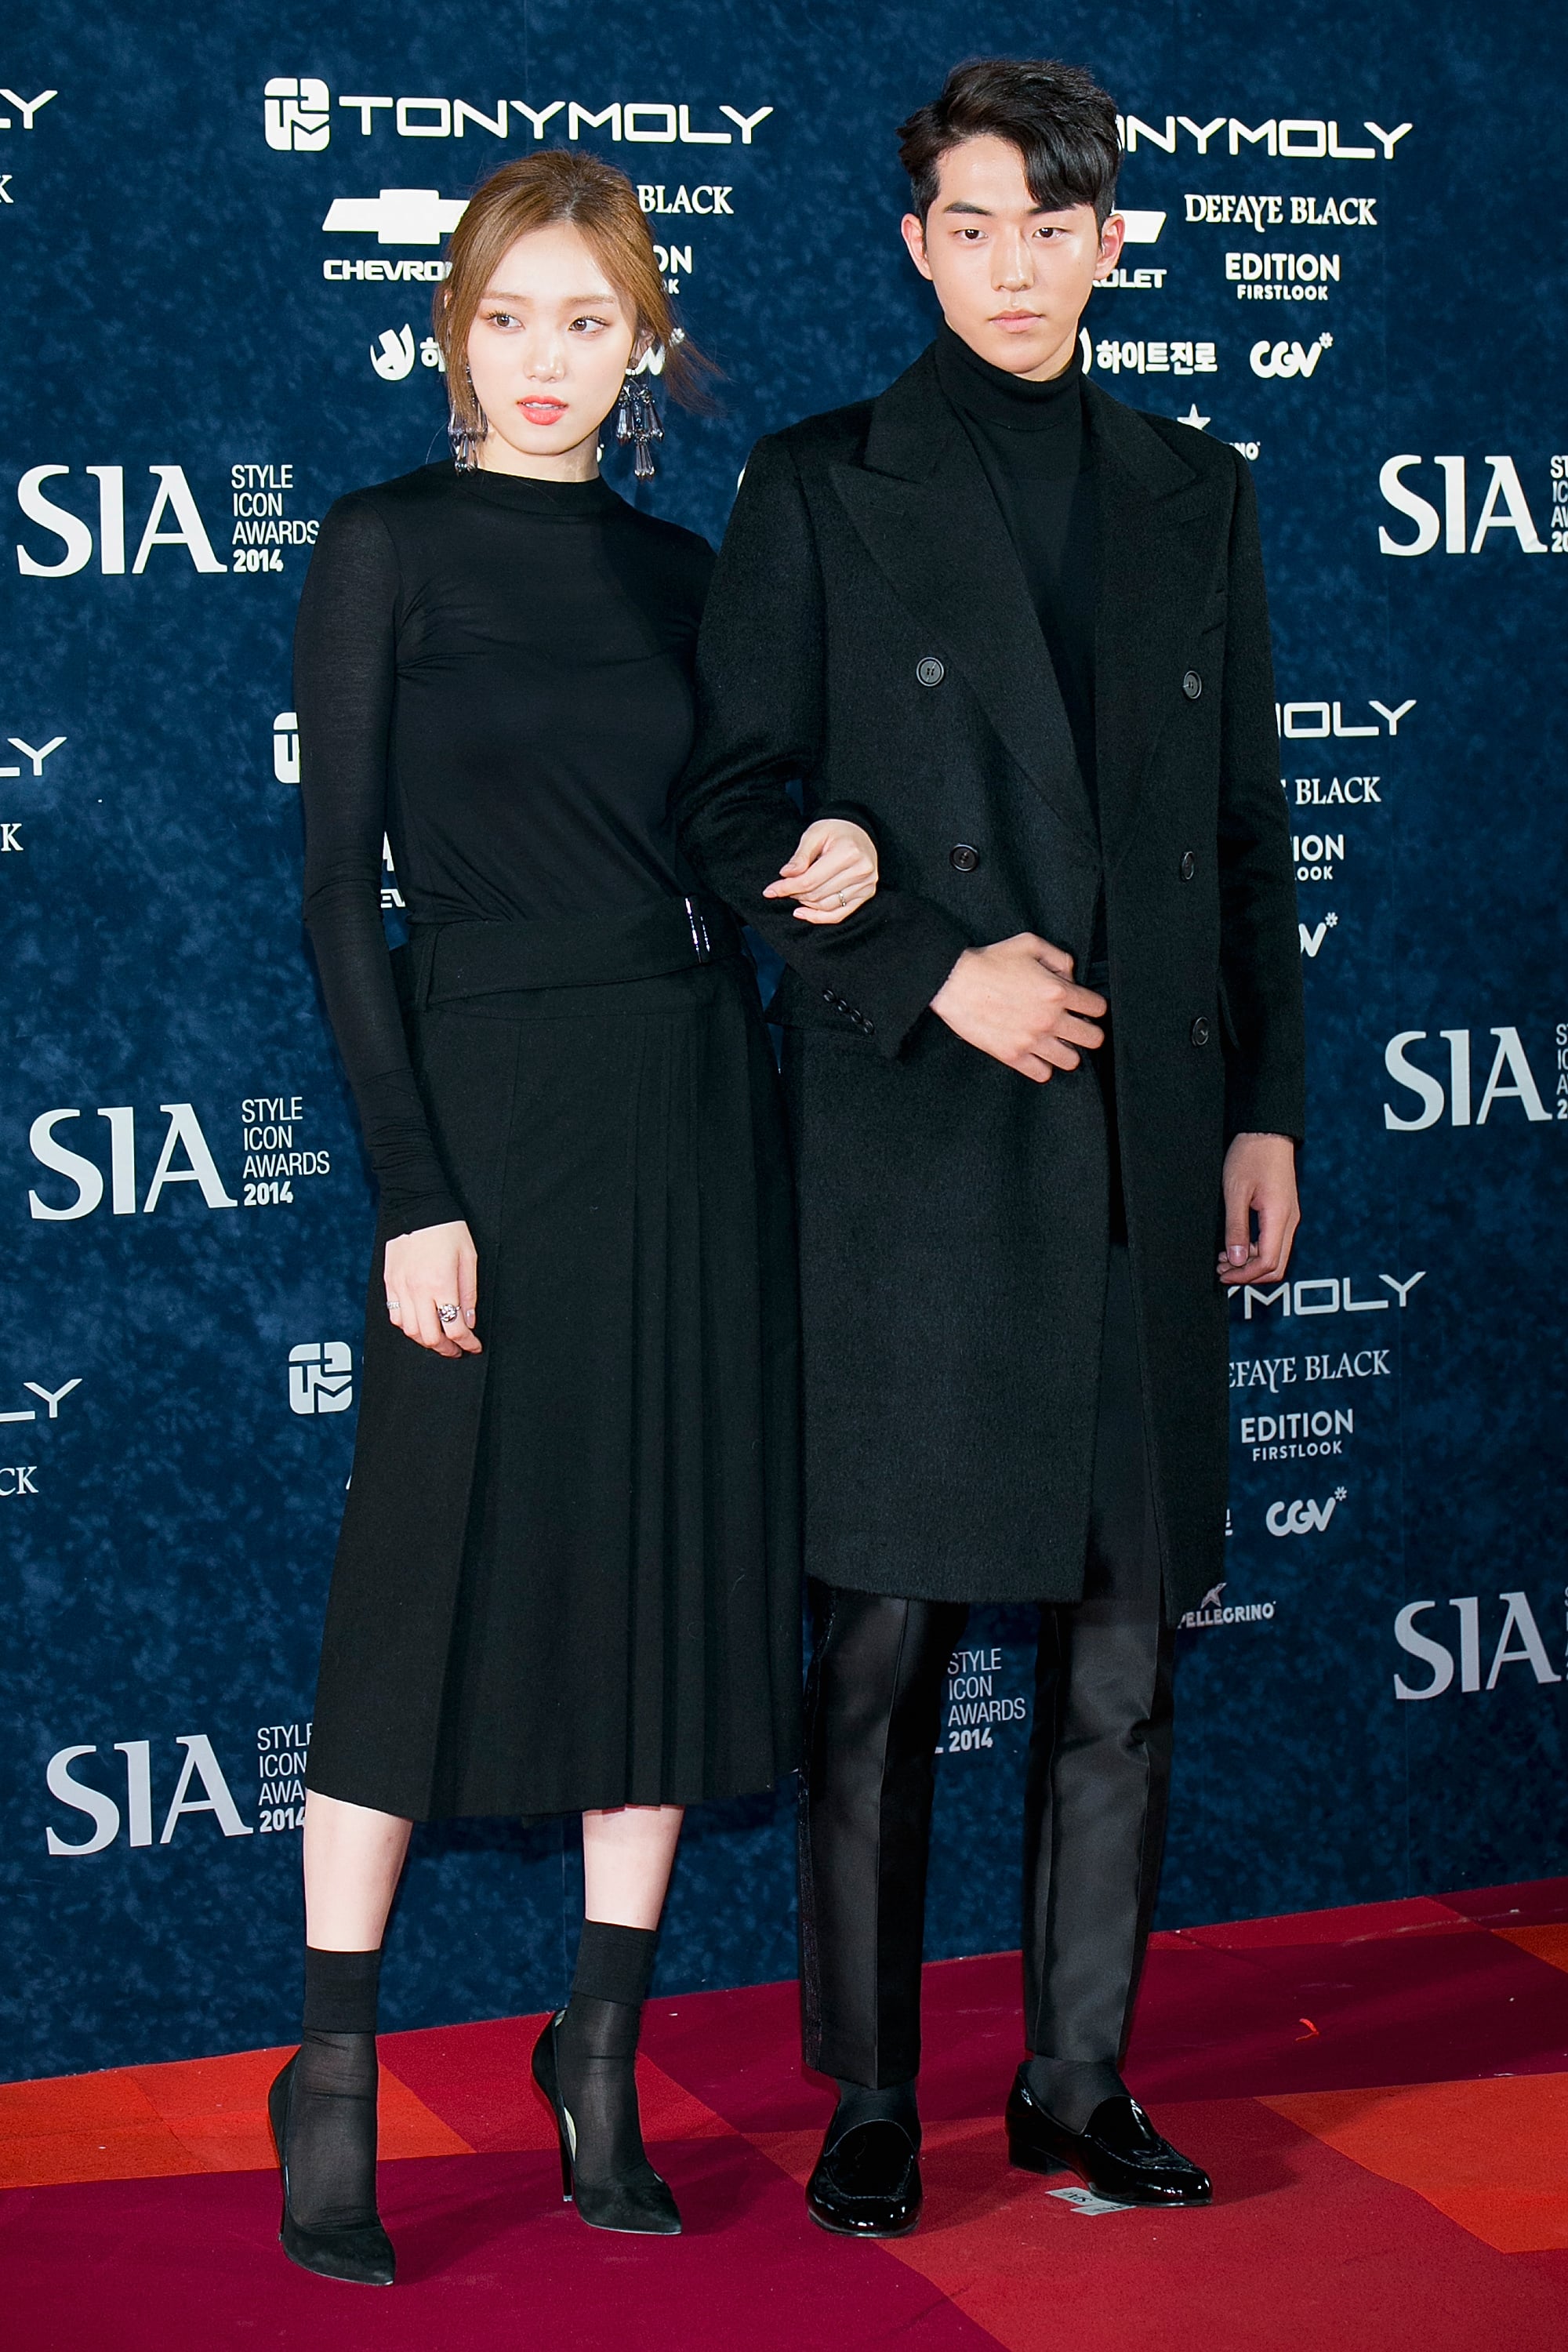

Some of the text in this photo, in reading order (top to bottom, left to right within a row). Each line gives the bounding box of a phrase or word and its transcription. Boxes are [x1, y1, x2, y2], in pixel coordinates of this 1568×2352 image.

[339, 96, 773, 144] TONYMOLY
[1116, 114, 1414, 160] NYMOLY
[637, 184, 734, 215] BLACK
[1185, 194, 1377, 233] DEFAYE BLACK
[1225, 252, 1340, 281] EDITION
[1237, 284, 1328, 301] FIRSTLOOK
[1096, 340, 1218, 376] 하이트진로
[1250, 339, 1323, 379] CGV
[231, 464, 293, 489] STYLE
[233, 492, 283, 517] ICON
[1378, 454, 1548, 557] SIA
[16, 464, 228, 578] SIA
[232, 520, 320, 545] AWARDS
[233, 548, 284, 573] 2014
[1295, 776, 1381, 805] BLACK
[1384, 1026, 1553, 1131] SIA
[241, 1096, 303, 1123] STYLE
[243, 1125, 293, 1151] ICON
[28, 1103, 238, 1221] SIA
[242, 1150, 330, 1179] AWARDS
[243, 1181, 294, 1207] 2014
[1305, 1349, 1391, 1382] BLACK
[1241, 1408, 1354, 1444] EDITION
[1252, 1440, 1343, 1461] FIRSTLOOK
[1265, 1497, 1337, 1537] CGV
[1394, 1592, 1562, 1700] SIA
[947, 1648, 1002, 1675] STYLE
[949, 1675, 993, 1701] ICON
[948, 1697, 1026, 1727] AWARDS
[949, 1727, 993, 1753] 2014
[259, 1751, 307, 1779] ICON
[45, 1733, 254, 1856] SIA
